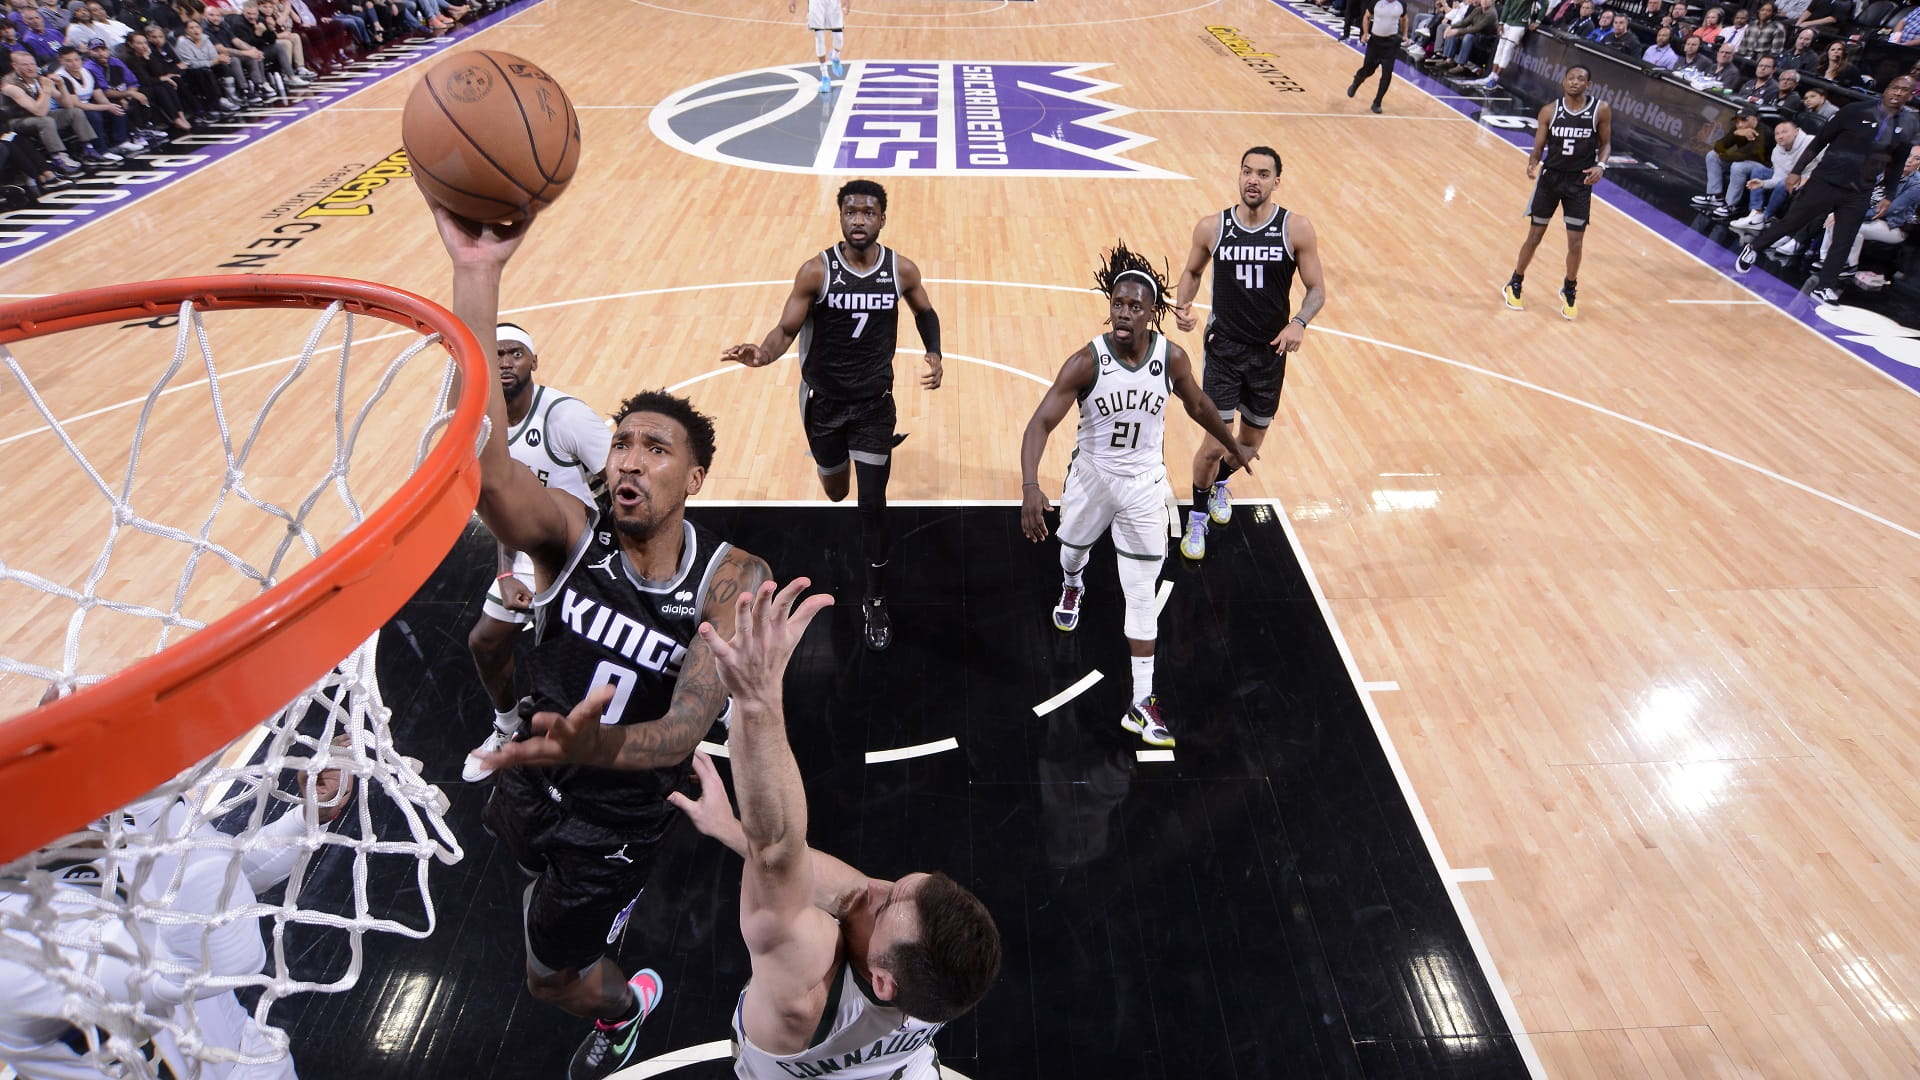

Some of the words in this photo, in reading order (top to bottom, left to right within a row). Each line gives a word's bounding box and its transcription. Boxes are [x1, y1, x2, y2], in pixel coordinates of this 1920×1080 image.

[1242, 57, 1306, 93] CENTER
[1512, 47, 1553, 80] thentic
[1613, 88, 1644, 119] Live
[1643, 102, 1682, 139] Here.
[833, 64, 939, 168] KINGS
[962, 65, 1009, 165] SACRAMENTO
[1551, 126, 1593, 138] KINGS
[1561, 138, 1576, 156] 5
[294, 146, 414, 219] lden1
[260, 187, 324, 220] Union
[832, 260, 839, 270] 6
[1219, 246, 1284, 262] KINGS
[1235, 264, 1264, 289] 41
[827, 293, 895, 310] KINGS
[851, 312, 870, 339] 7
[1101, 354, 1111, 365] 6
[1094, 389, 1164, 417] BUCKS
[1110, 421, 1141, 449] 21
[599, 531, 612, 546] 6
[661, 603, 695, 616] dialpa
[584, 660, 638, 725] 0
